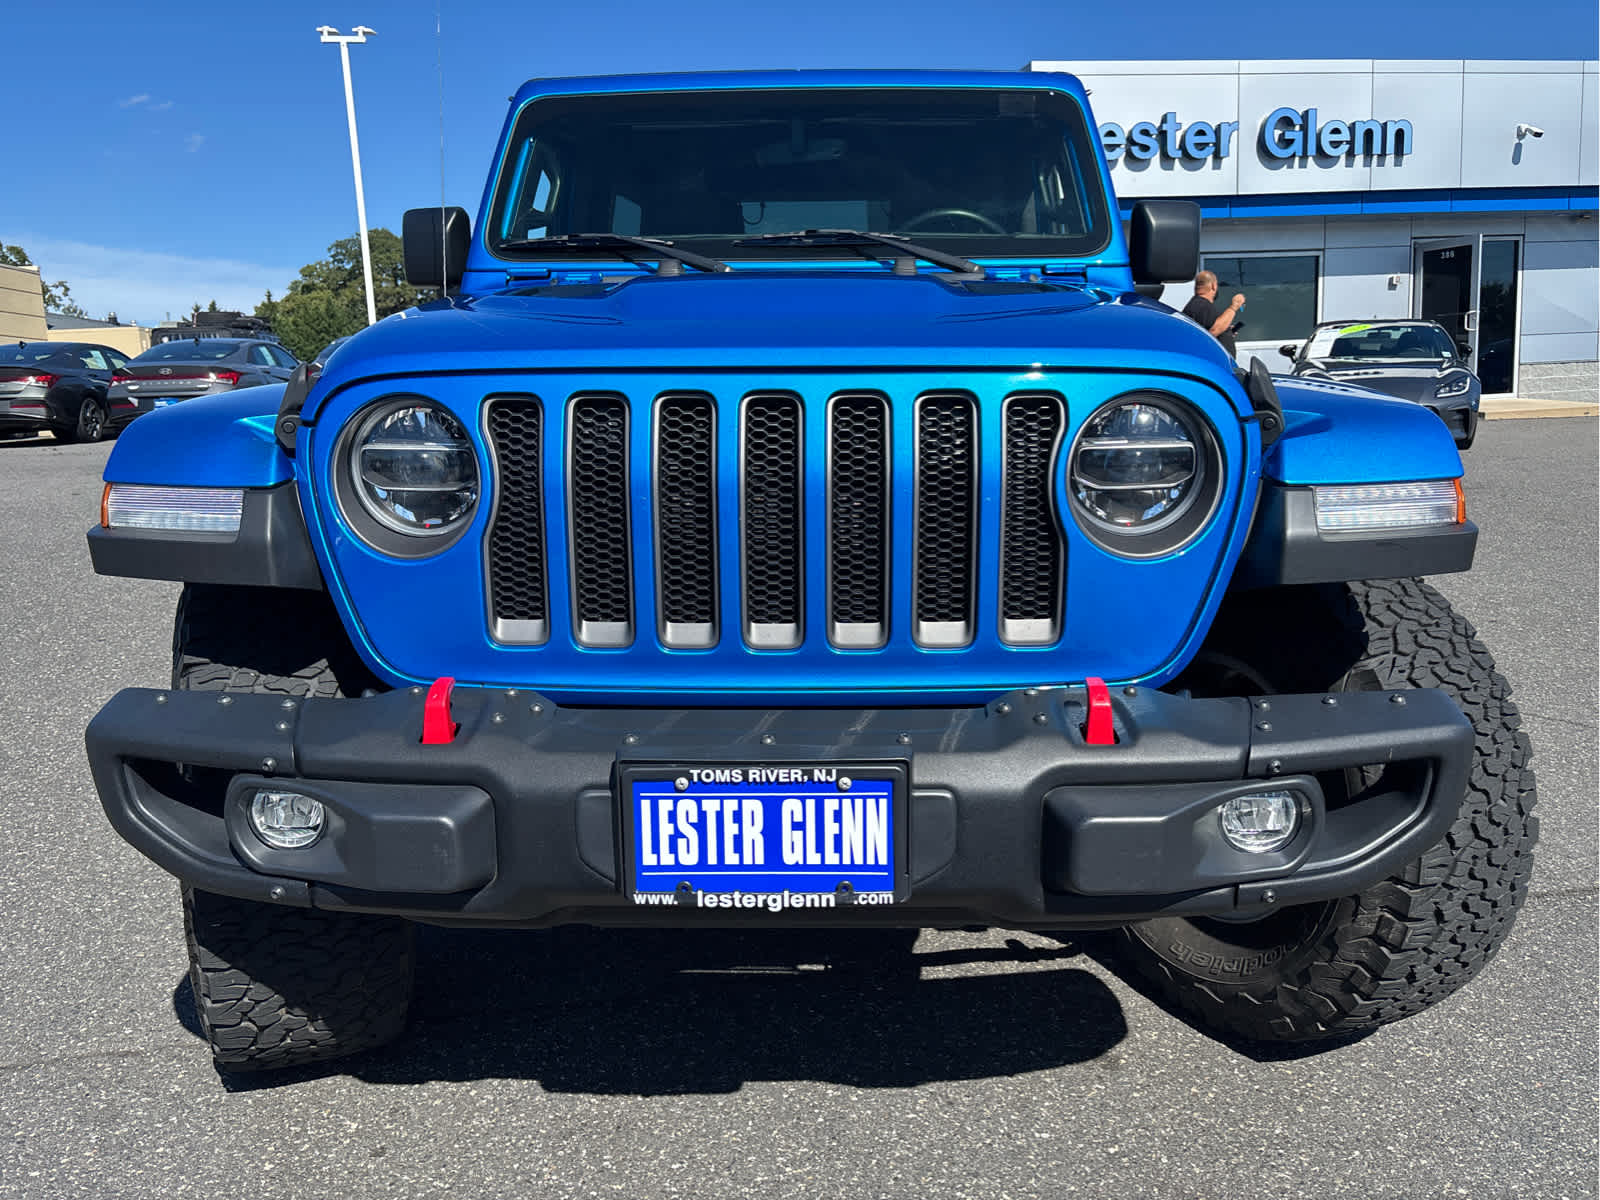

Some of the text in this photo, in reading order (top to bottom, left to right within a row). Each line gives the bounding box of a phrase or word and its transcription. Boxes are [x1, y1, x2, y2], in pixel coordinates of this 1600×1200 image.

[1099, 107, 1413, 159] ester Glenn
[690, 769, 837, 783] TOMS RIVER, NJ
[641, 798, 888, 865] LESTER GLENN
[633, 890, 894, 911] www. lesterglenn .com
